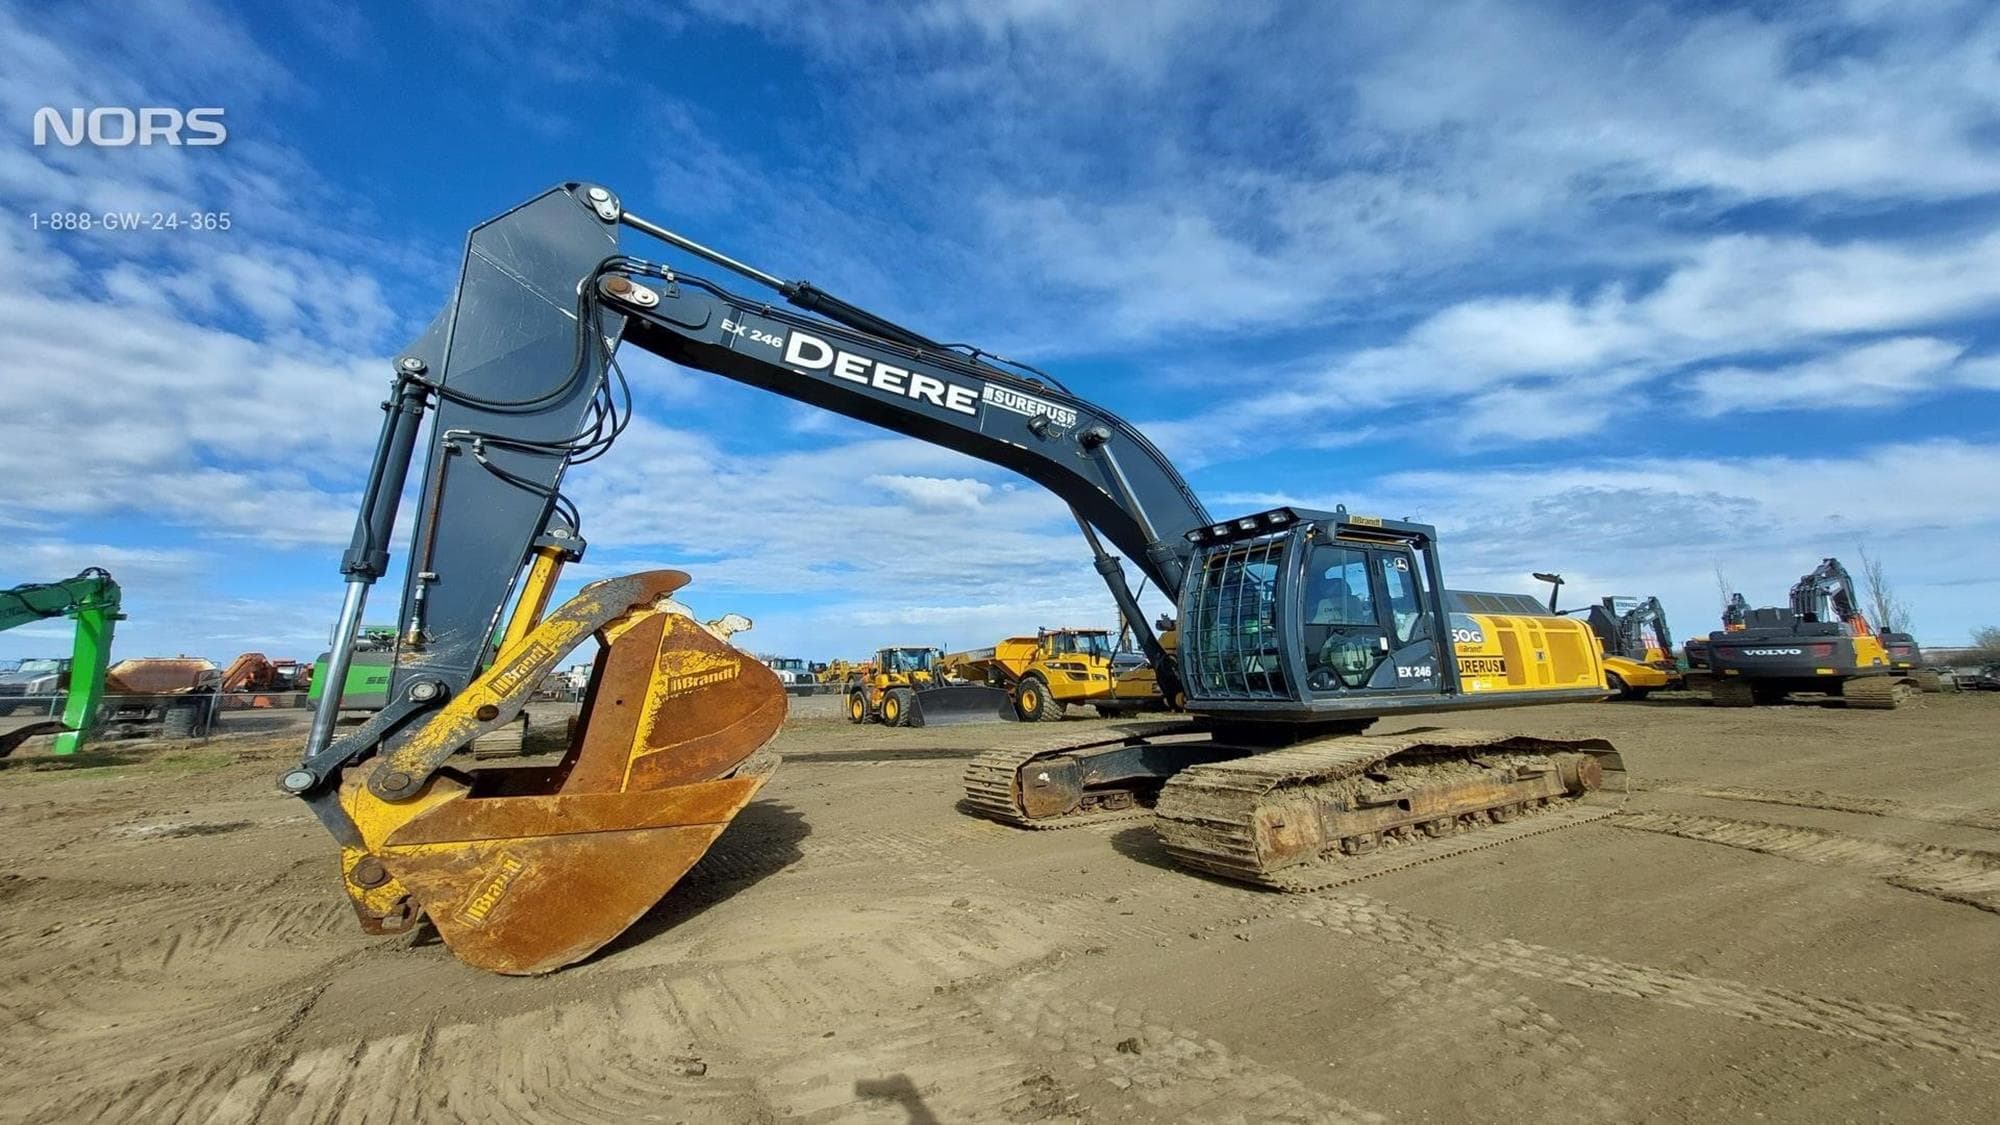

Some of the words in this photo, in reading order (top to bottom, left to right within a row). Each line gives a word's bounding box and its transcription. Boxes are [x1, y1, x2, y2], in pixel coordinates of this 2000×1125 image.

[721, 318, 747, 337] EX
[749, 329, 783, 348] 246
[784, 330, 979, 416] DEERE
[500, 644, 549, 688] Brandt
[681, 667, 733, 689] Brandt
[1398, 666, 1412, 678] EX
[1413, 666, 1431, 677] 246
[1459, 660, 1500, 673] URERUS
